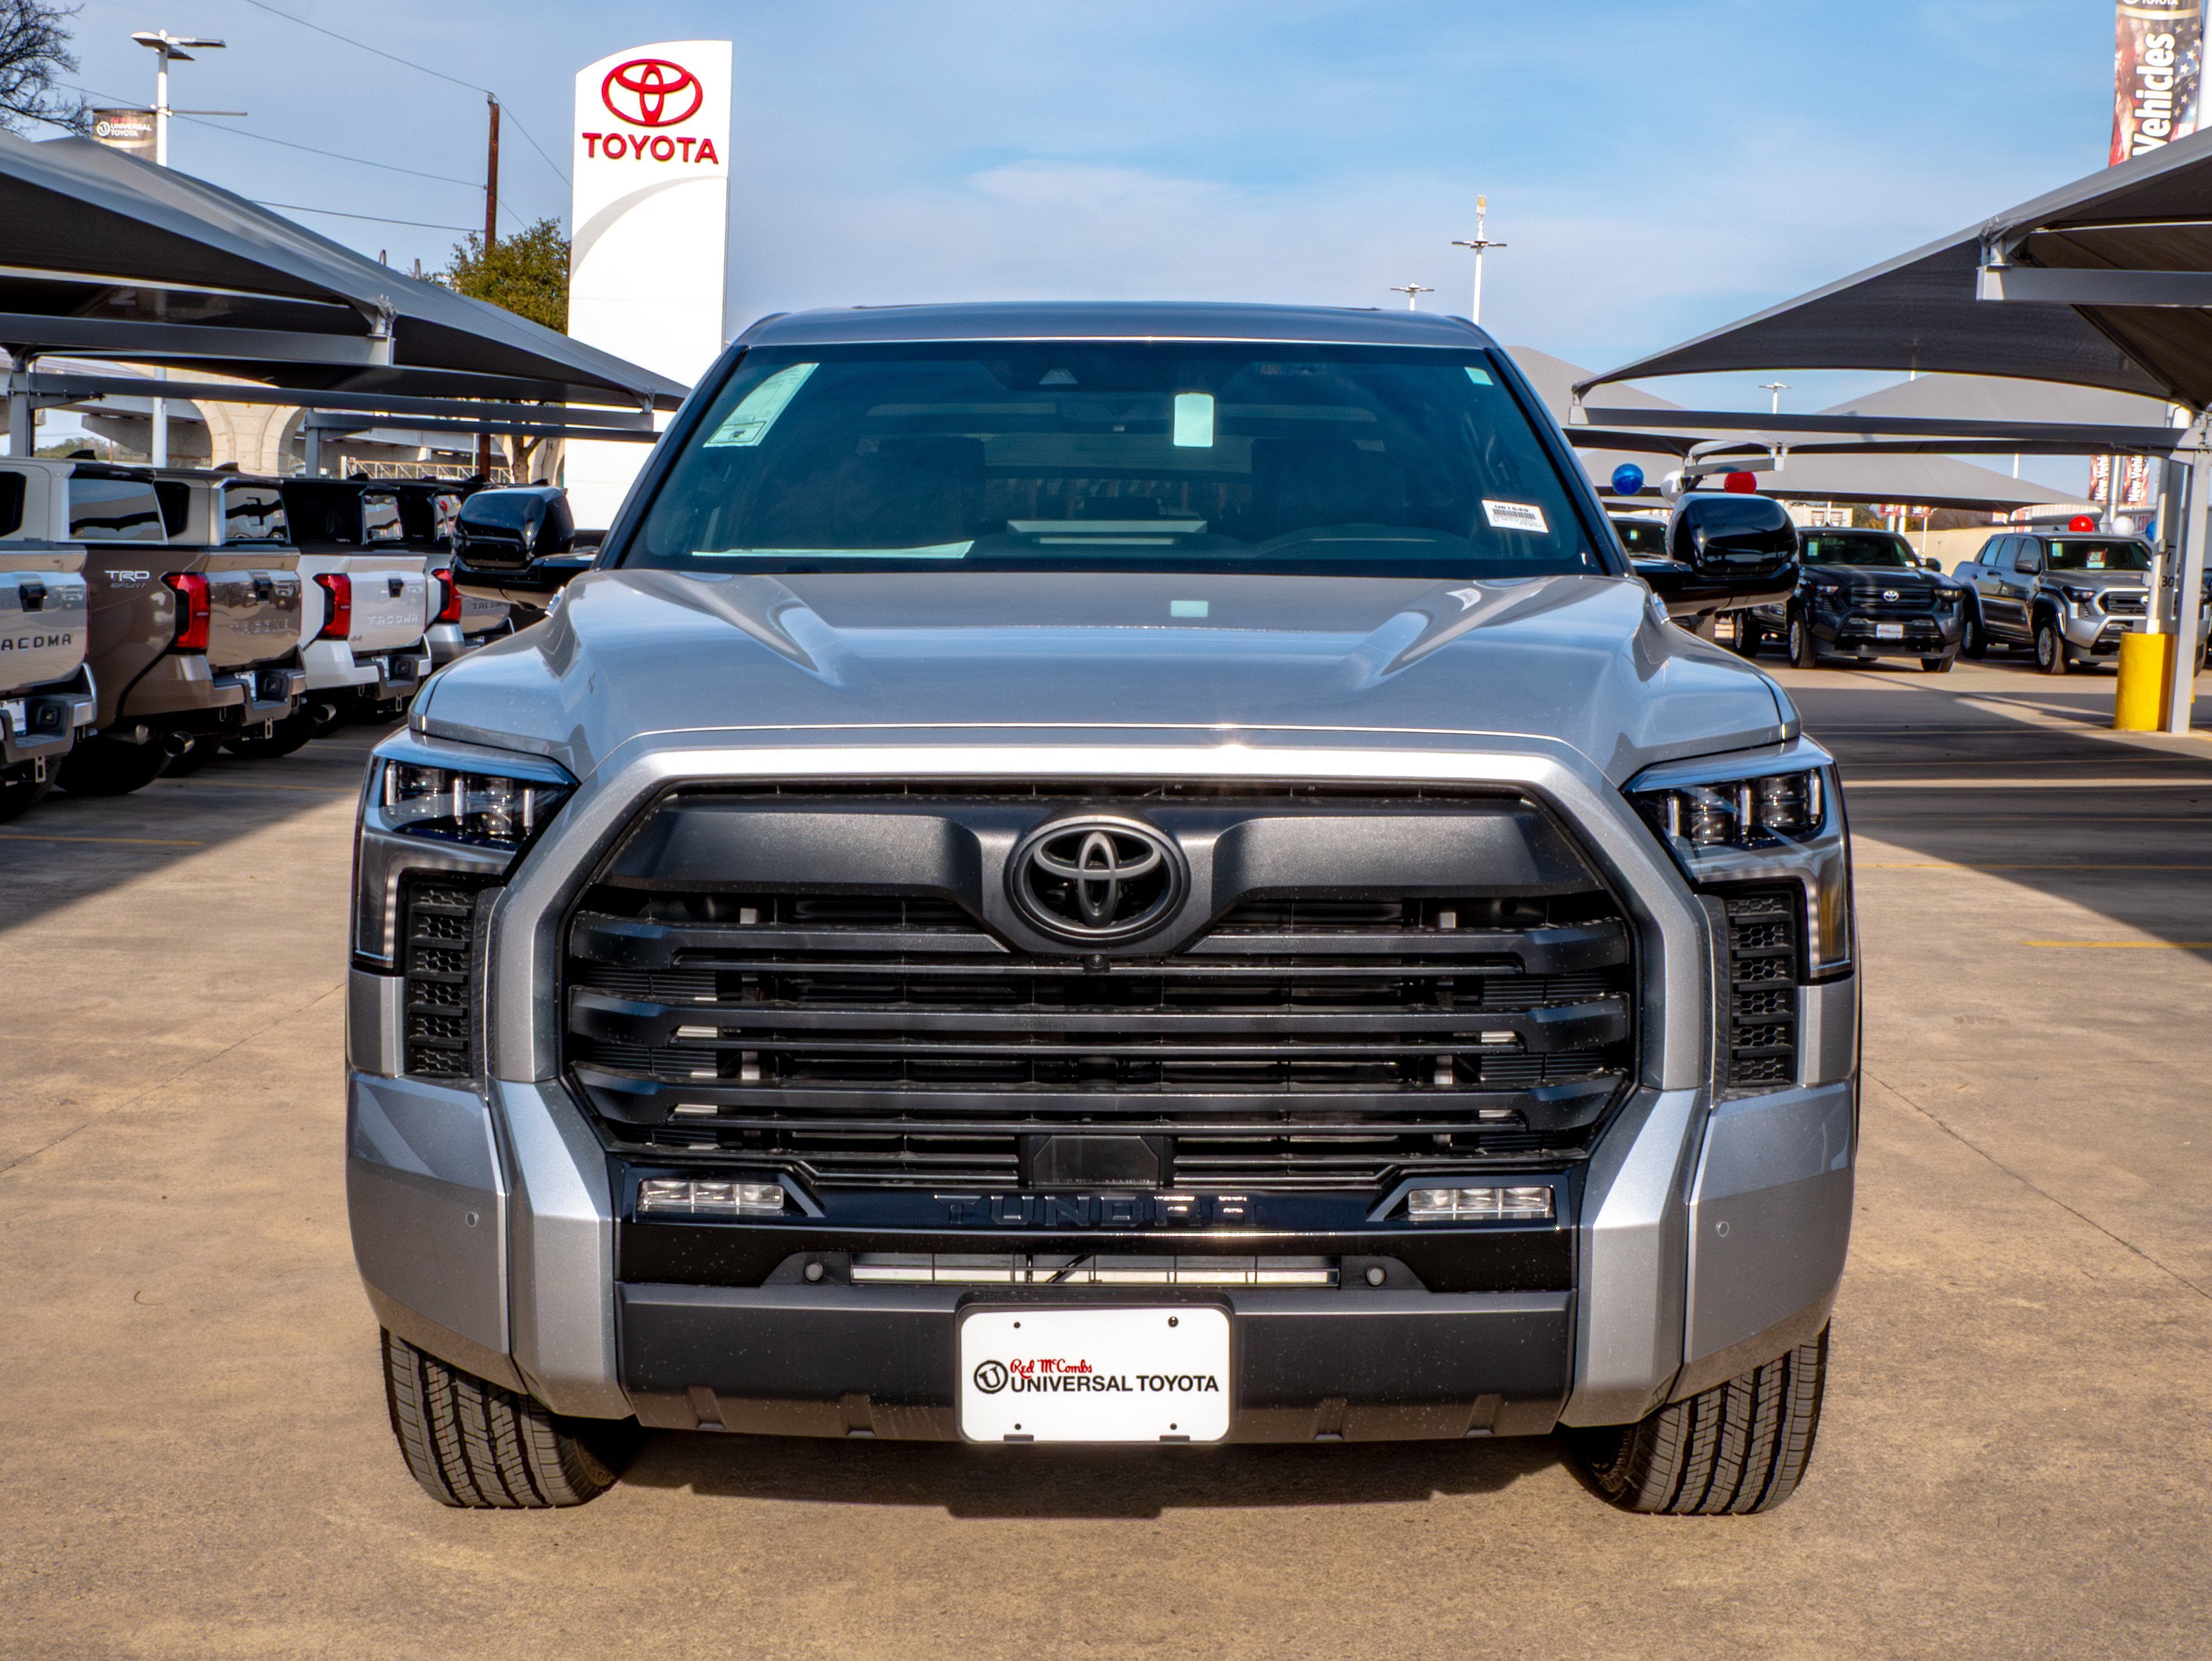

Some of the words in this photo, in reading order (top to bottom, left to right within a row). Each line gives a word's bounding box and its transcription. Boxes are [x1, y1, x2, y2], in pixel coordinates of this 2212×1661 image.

[2131, 33, 2175, 156] Vehicles
[111, 123, 151, 131] UNIVERSAL
[582, 133, 719, 164] TOYOTA
[2127, 479, 2142, 501] New
[104, 570, 150, 582] TRD
[367, 613, 418, 625] TACOMA
[934, 1194, 1256, 1227] TUNDRA
[1010, 1359, 1035, 1379] Red
[1037, 1359, 1093, 1374] McCombs
[1011, 1375, 1133, 1393] UNIVERSAL
[1137, 1375, 1219, 1392] TOYOTA
